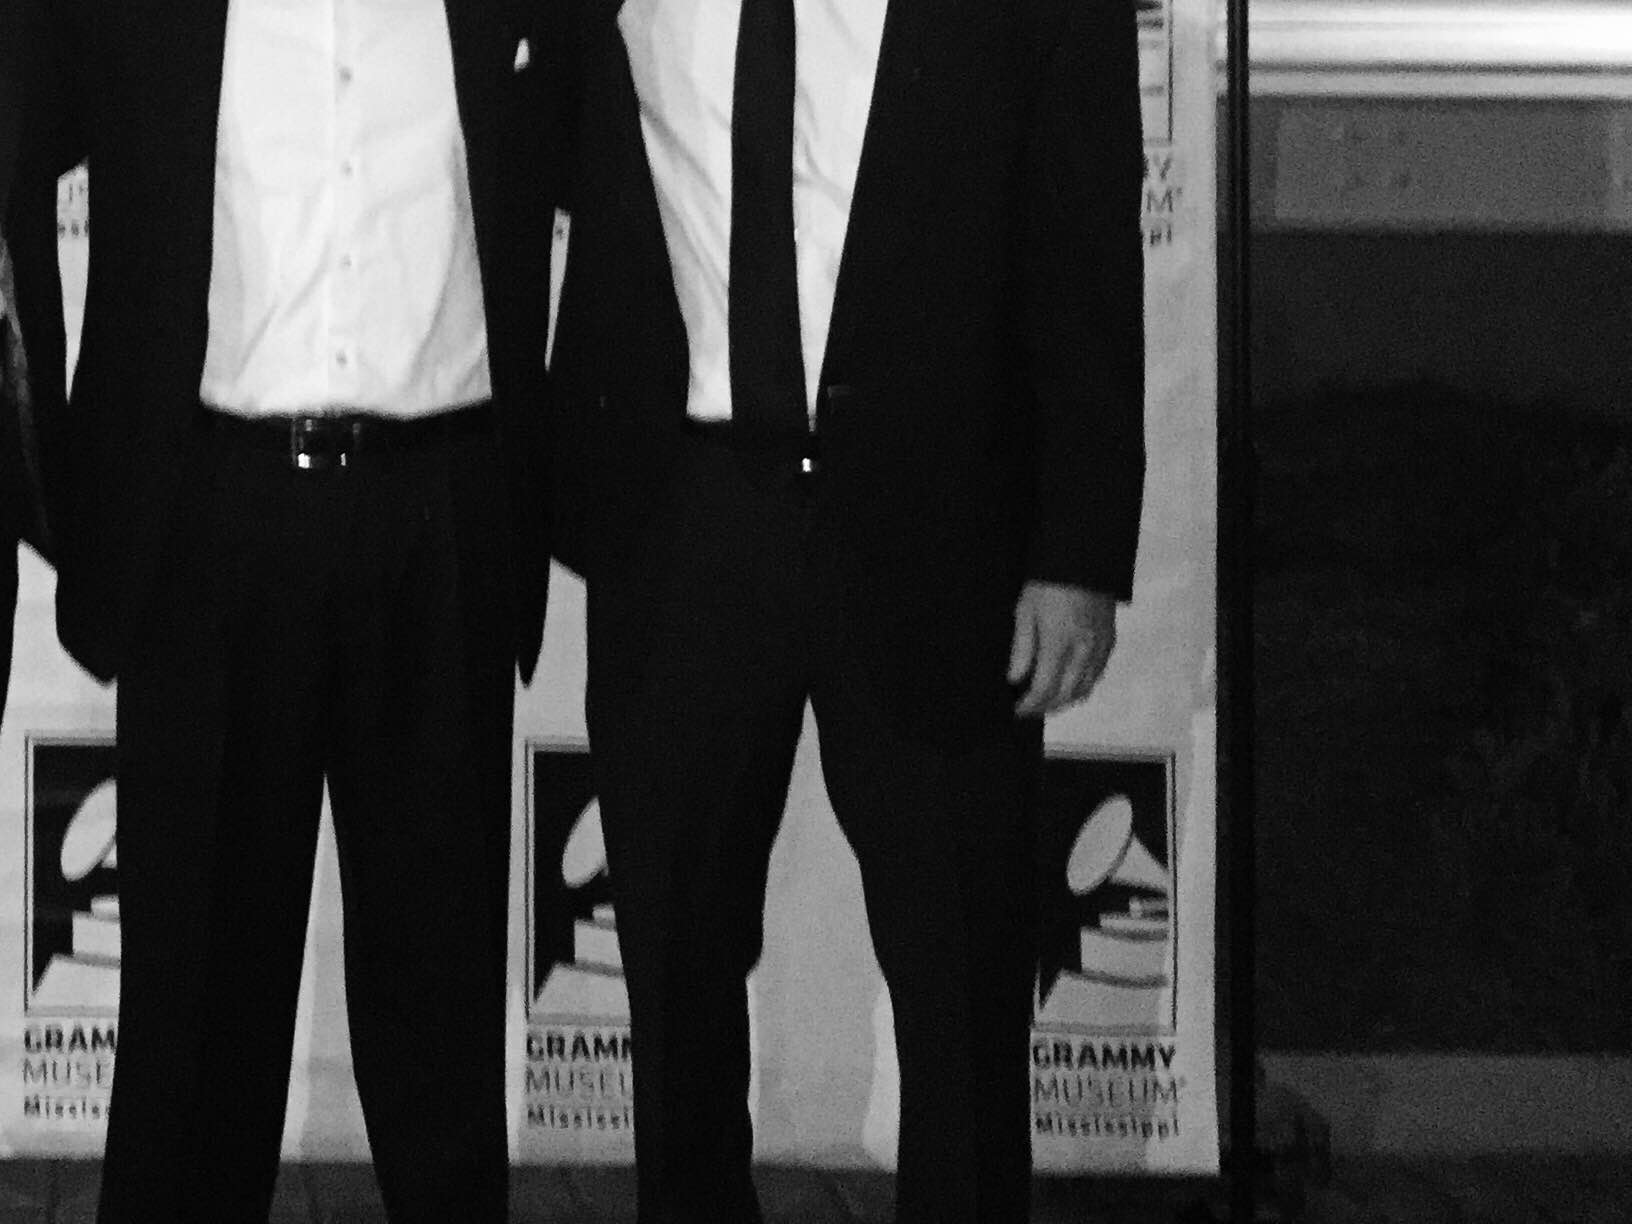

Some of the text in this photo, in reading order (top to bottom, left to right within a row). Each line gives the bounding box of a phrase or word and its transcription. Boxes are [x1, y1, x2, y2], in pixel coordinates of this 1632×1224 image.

[24, 1025, 117, 1053] GRAM
[526, 1032, 632, 1062] GRAM
[1033, 1041, 1176, 1072] GRAMMY
[23, 1058, 113, 1089] MUSE
[527, 1104, 630, 1129] Mississi
[1035, 1116, 1179, 1138] Mississippi
